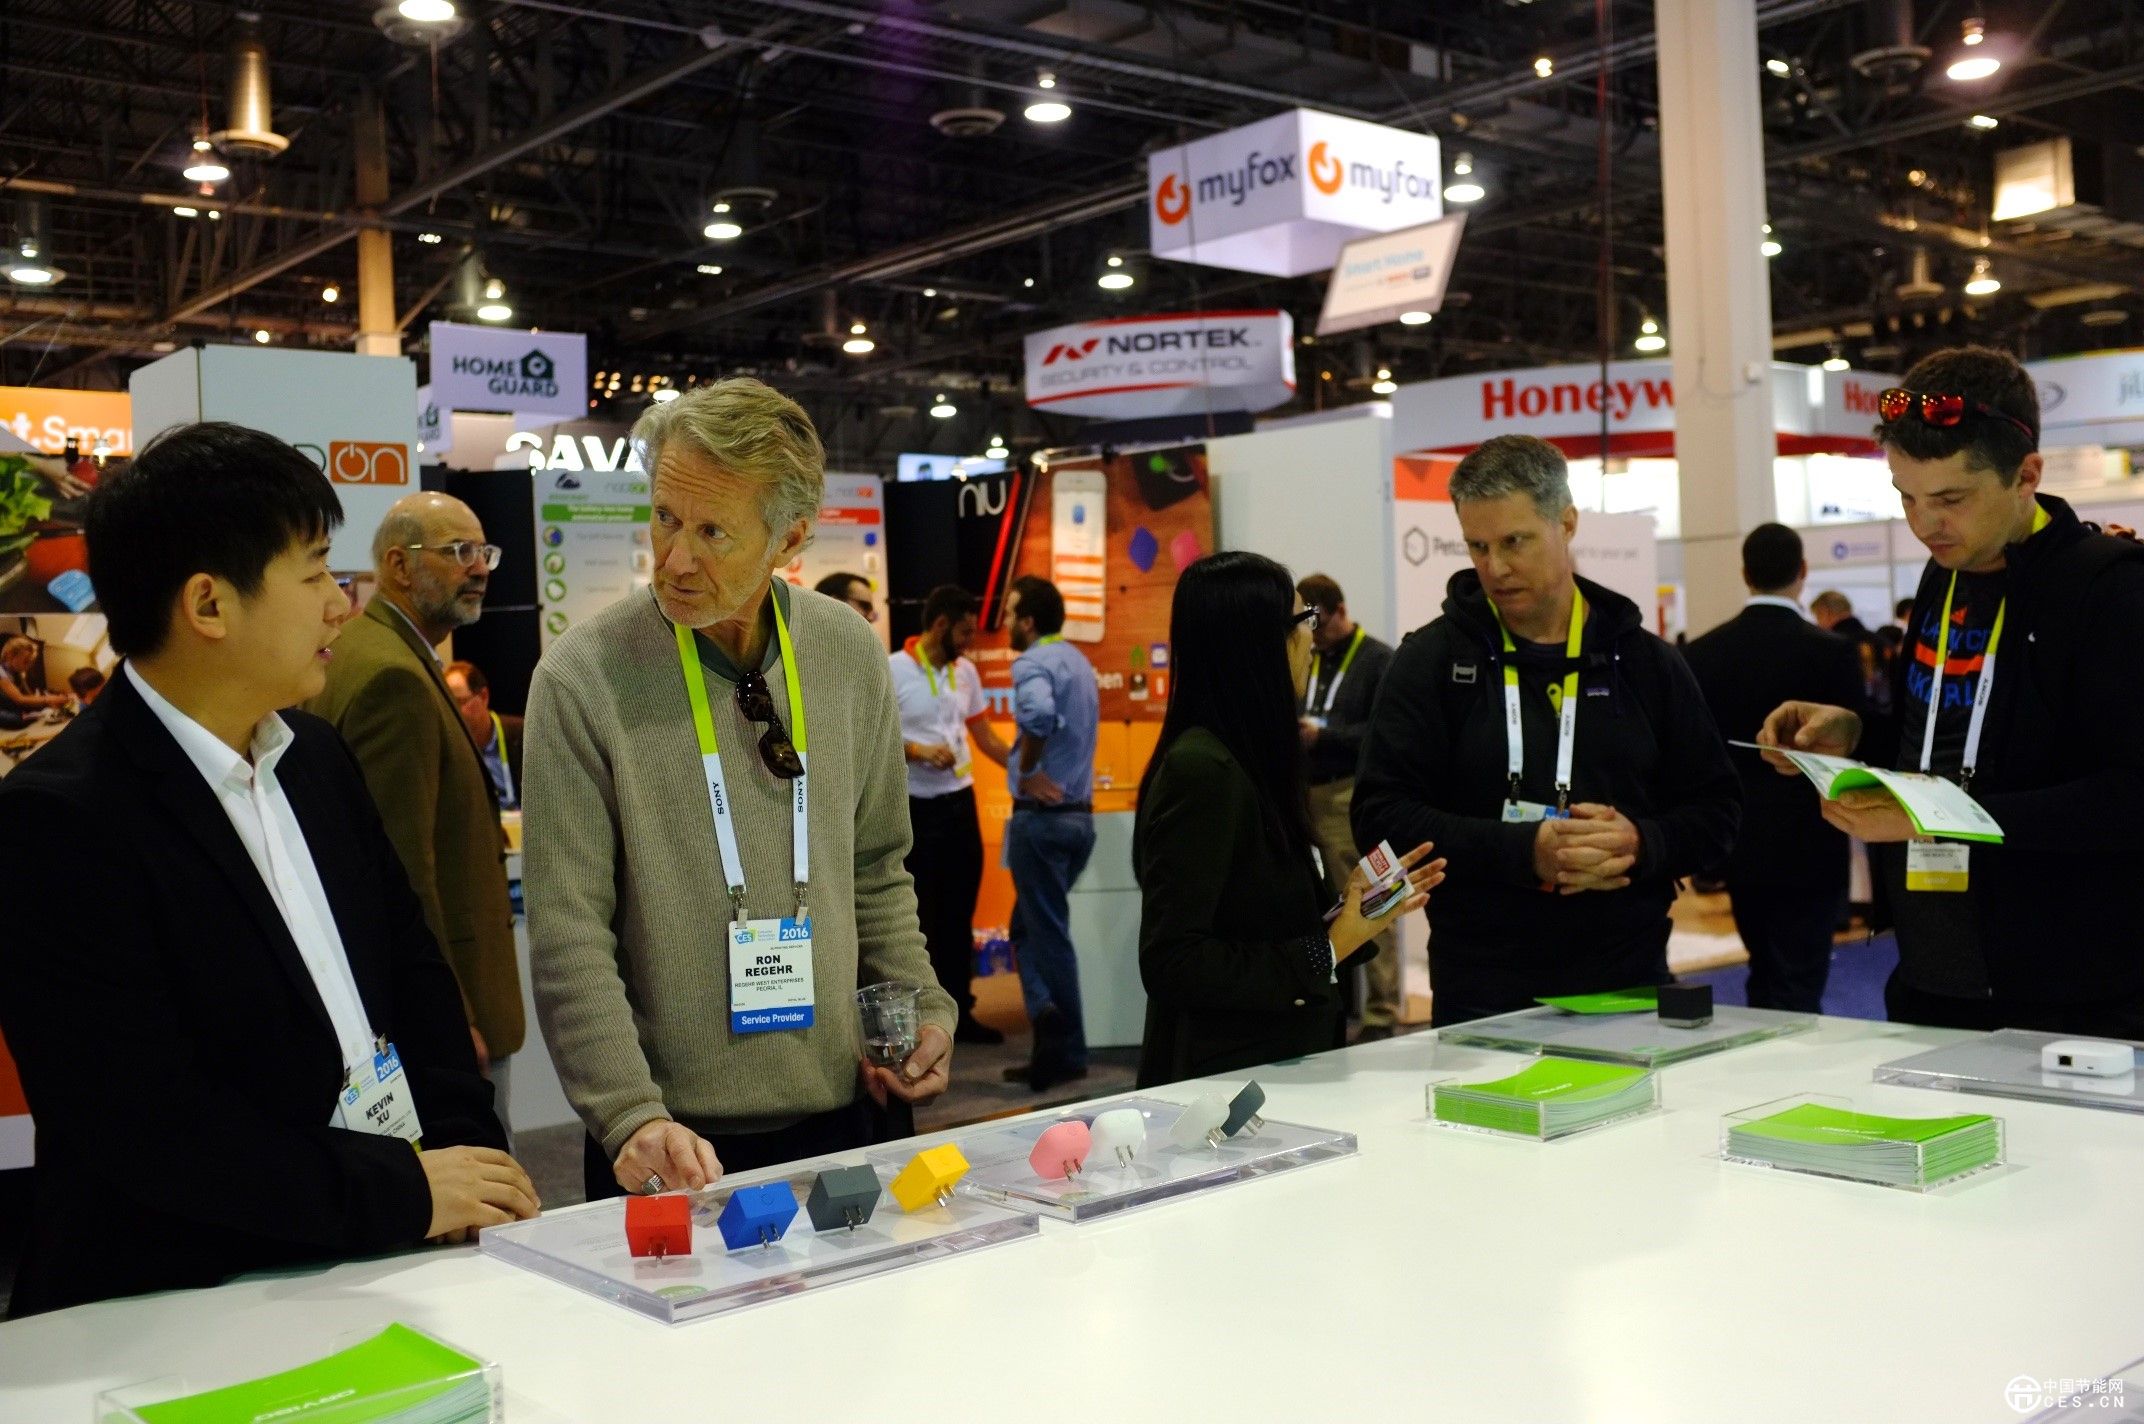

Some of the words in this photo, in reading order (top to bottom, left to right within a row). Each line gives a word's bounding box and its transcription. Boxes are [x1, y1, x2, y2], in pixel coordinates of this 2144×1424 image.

[1199, 152, 1296, 205] myfox
[1350, 160, 1435, 204] myfox
[1107, 327, 1249, 355] NORTEK
[452, 355, 515, 377] HOME
[1040, 364, 1124, 386] SECURITY
[488, 378, 559, 398] GUARD
[712, 781, 725, 815] SONY
[736, 933, 753, 943] CES
[781, 927, 809, 940] 2016
[745, 965, 793, 977] REGEHR
[756, 955, 781, 966] RON
[770, 977, 805, 986] ENTERPRISES
[741, 1014, 771, 1025] Service
[772, 1012, 805, 1023] Provider
[376, 1057, 400, 1079] 2016
[365, 1091, 394, 1120] KEVIN
[376, 1109, 391, 1127] XU
